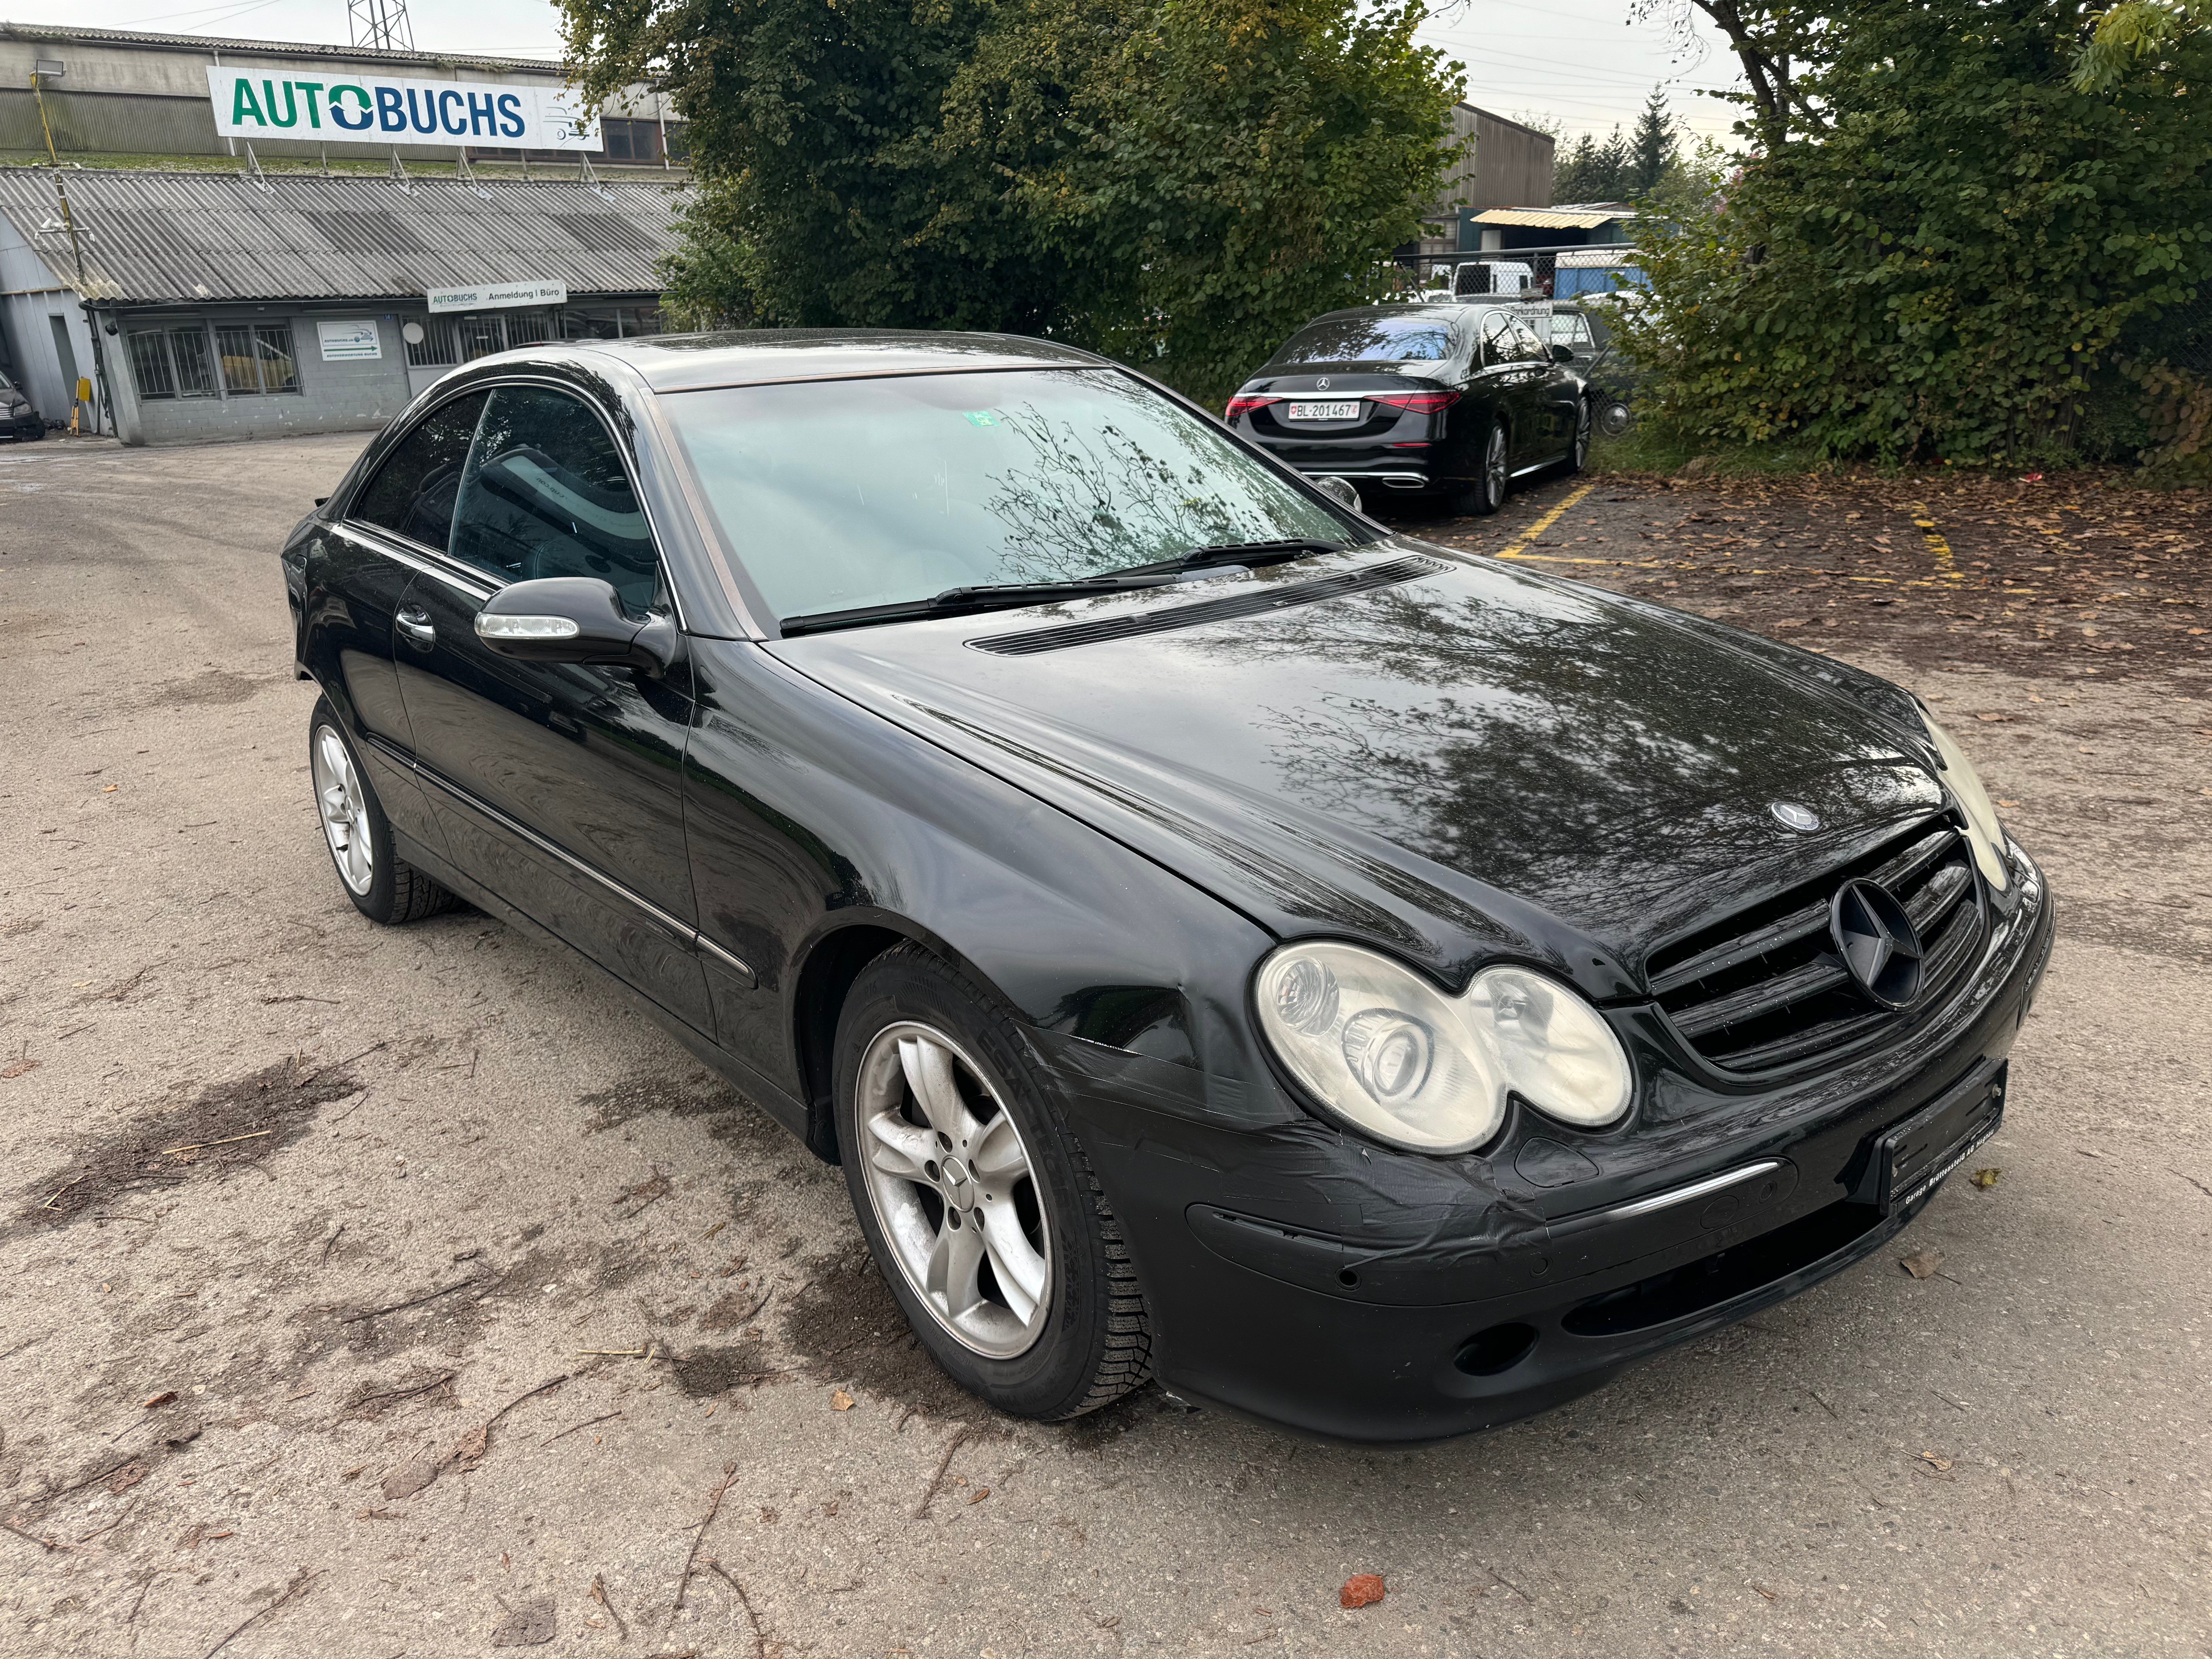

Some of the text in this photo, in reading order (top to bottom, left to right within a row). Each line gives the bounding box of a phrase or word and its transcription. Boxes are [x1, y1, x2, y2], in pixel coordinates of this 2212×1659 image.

[232, 78, 525, 137] AUTOBUCHS
[433, 293, 477, 303] AUTOBUCHS
[488, 290, 533, 300] Anmeldung
[1906, 1185, 1926, 1204] Garage
[1966, 1145, 1974, 1156] AG
[1976, 1129, 1994, 1148] Hegnau
